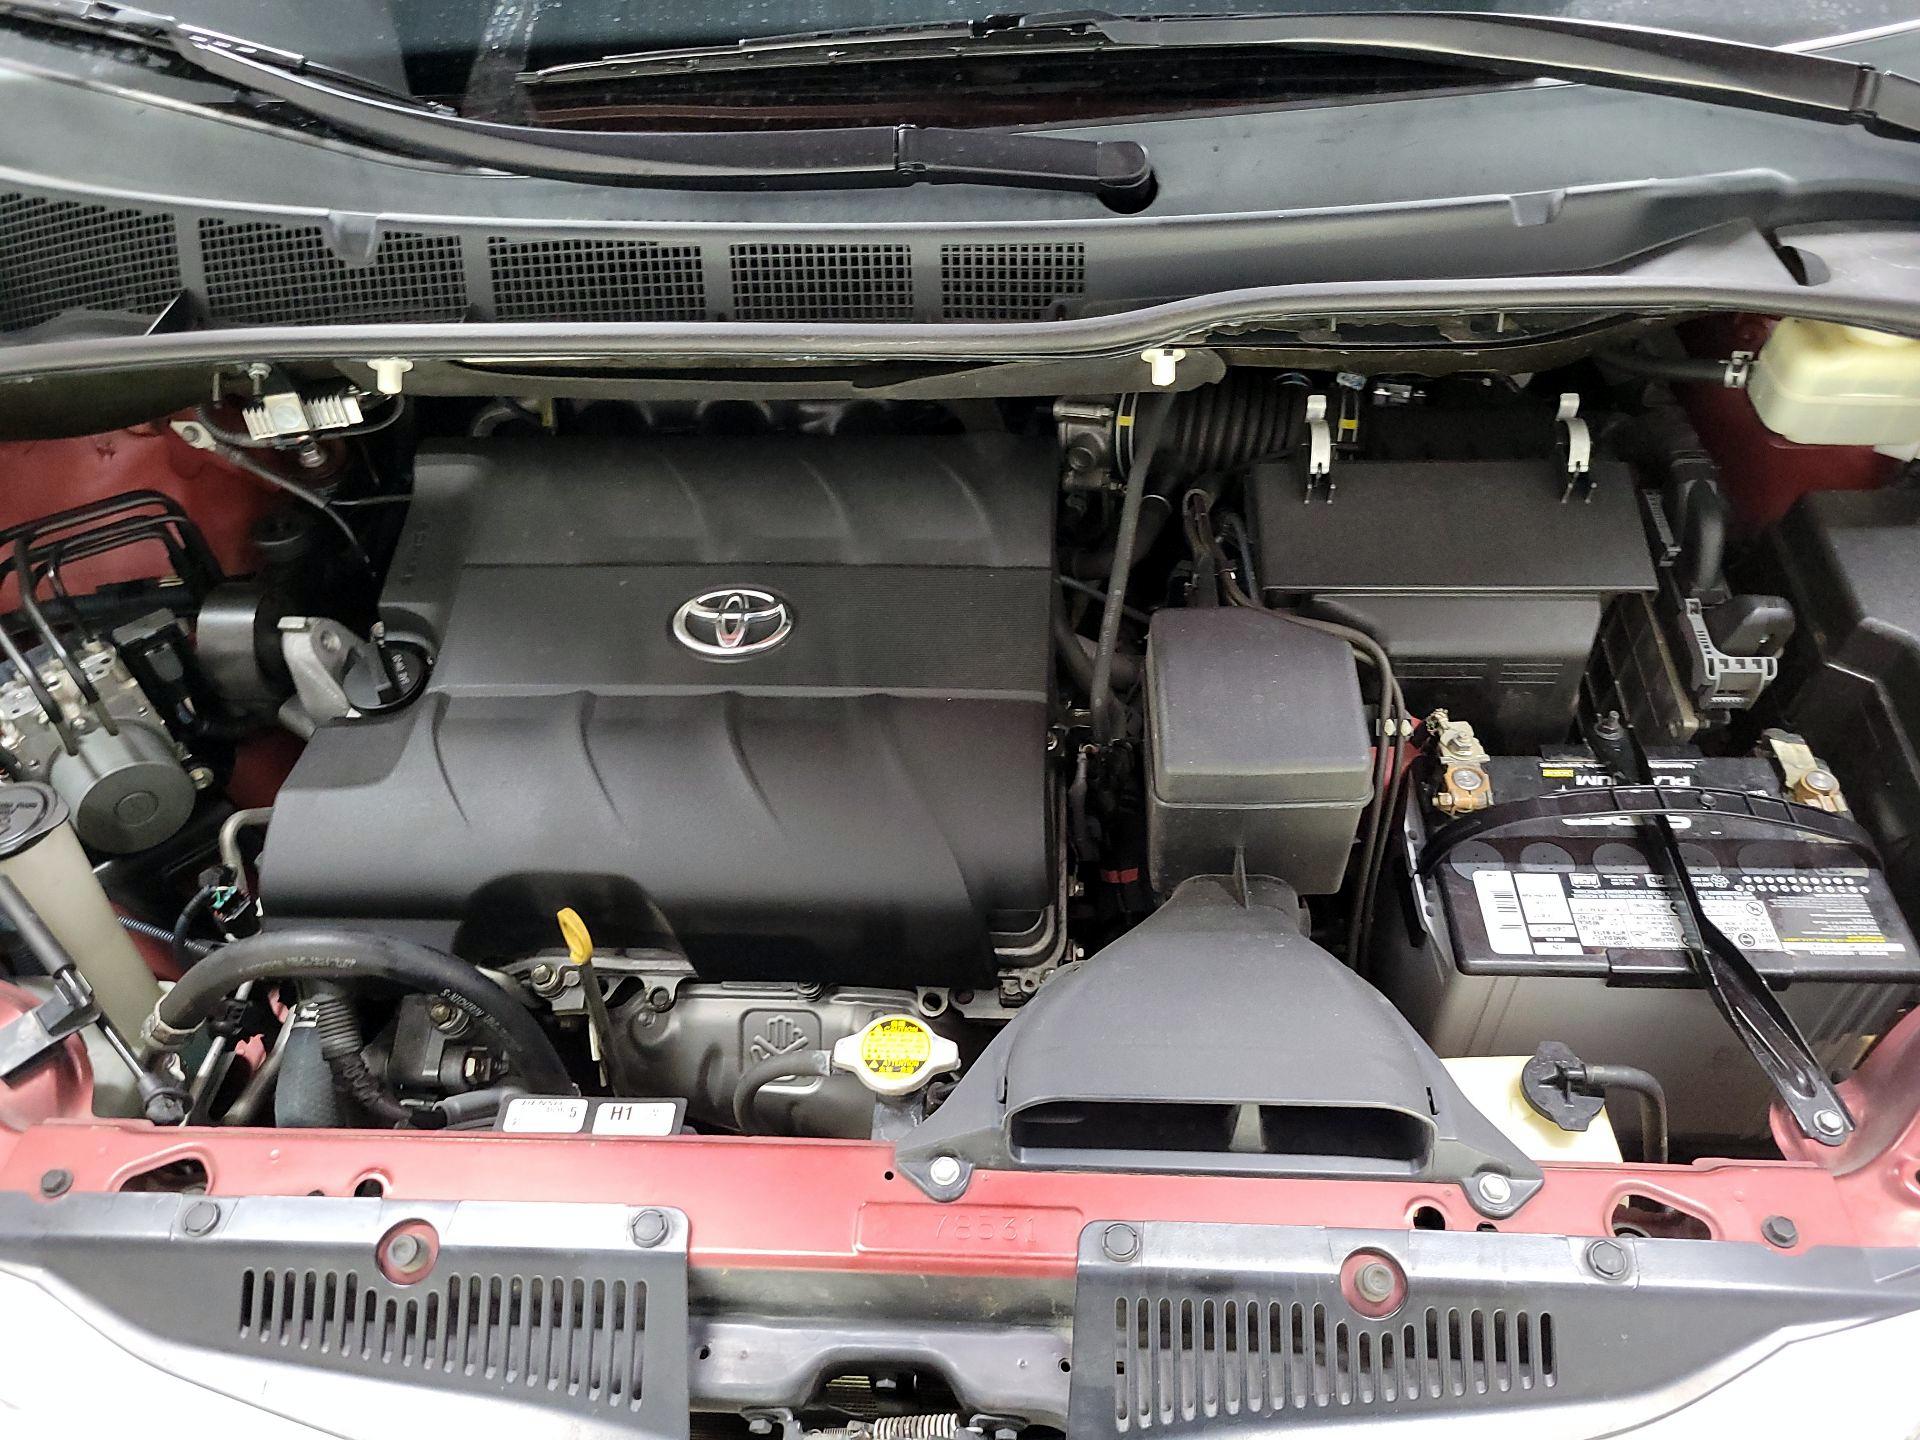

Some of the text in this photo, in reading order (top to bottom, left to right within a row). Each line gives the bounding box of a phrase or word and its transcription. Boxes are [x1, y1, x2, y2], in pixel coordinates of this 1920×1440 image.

[1575, 774, 1691, 787] PLAUM
[609, 1105, 633, 1121] H1
[934, 1213, 1038, 1244] 78531
